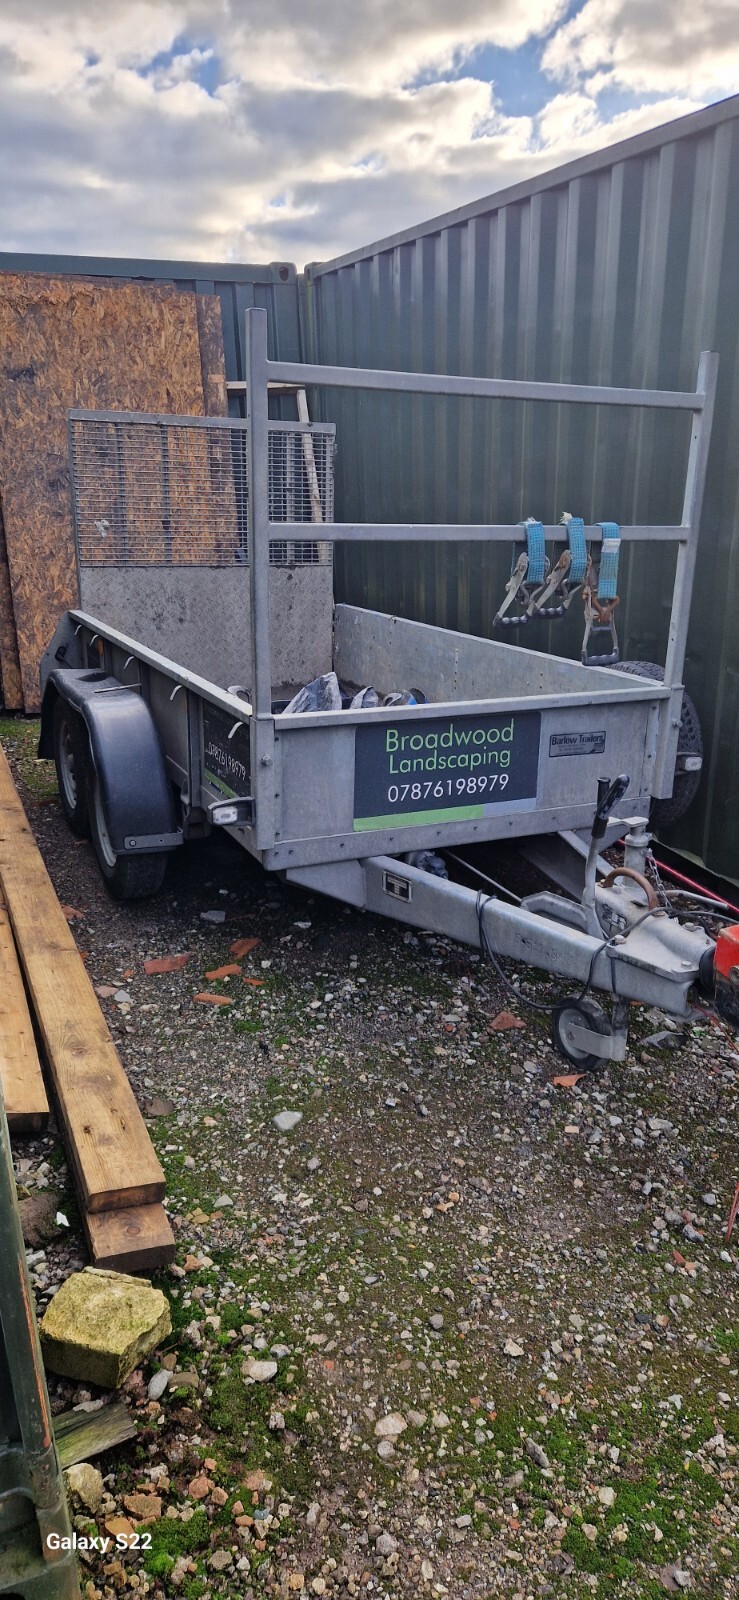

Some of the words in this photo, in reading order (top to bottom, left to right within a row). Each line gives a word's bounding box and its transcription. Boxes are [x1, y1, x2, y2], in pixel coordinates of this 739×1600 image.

[386, 718, 514, 752] Broadwood
[551, 736, 577, 745] Barlow
[579, 733, 603, 743] Trailers
[388, 746, 510, 774] Landscaping
[387, 774, 509, 803] 07876198979
